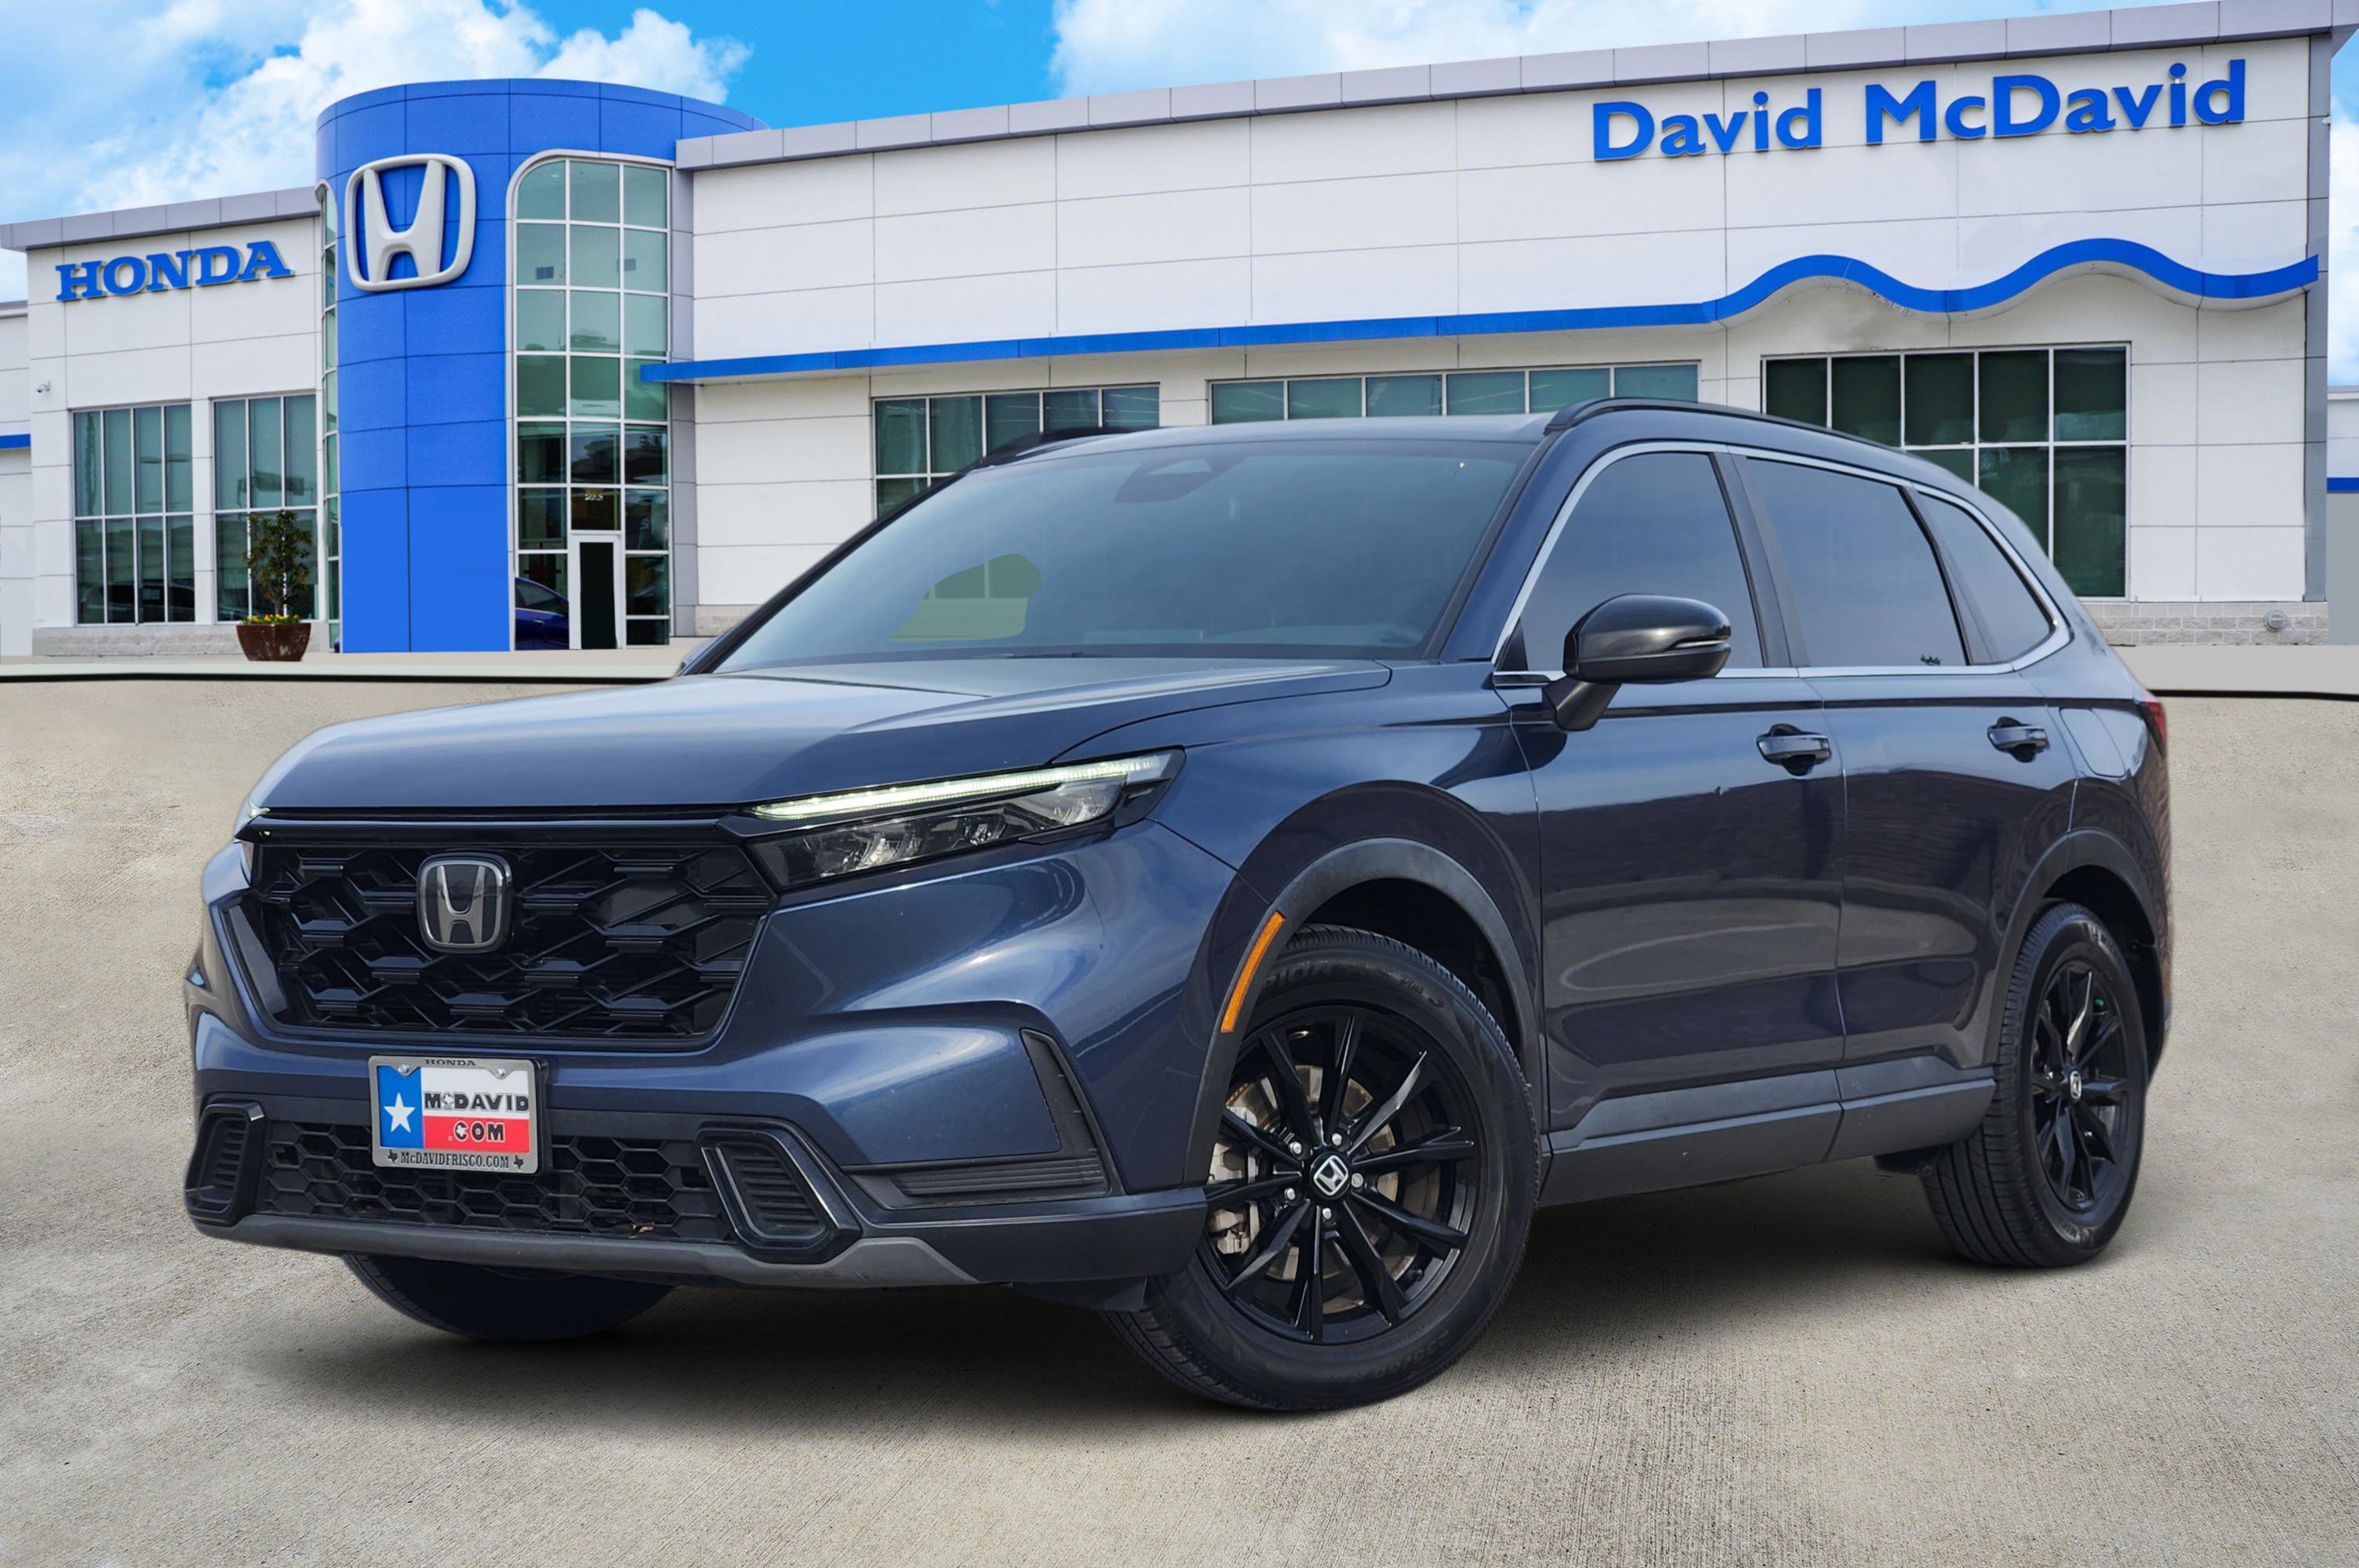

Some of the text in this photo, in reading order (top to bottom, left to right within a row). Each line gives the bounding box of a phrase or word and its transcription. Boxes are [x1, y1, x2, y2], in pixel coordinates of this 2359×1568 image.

[1592, 59, 2247, 162] David McDavid
[56, 240, 294, 303] HONDA
[400, 1151, 510, 1168] McDAVIDFRISCO.COM
